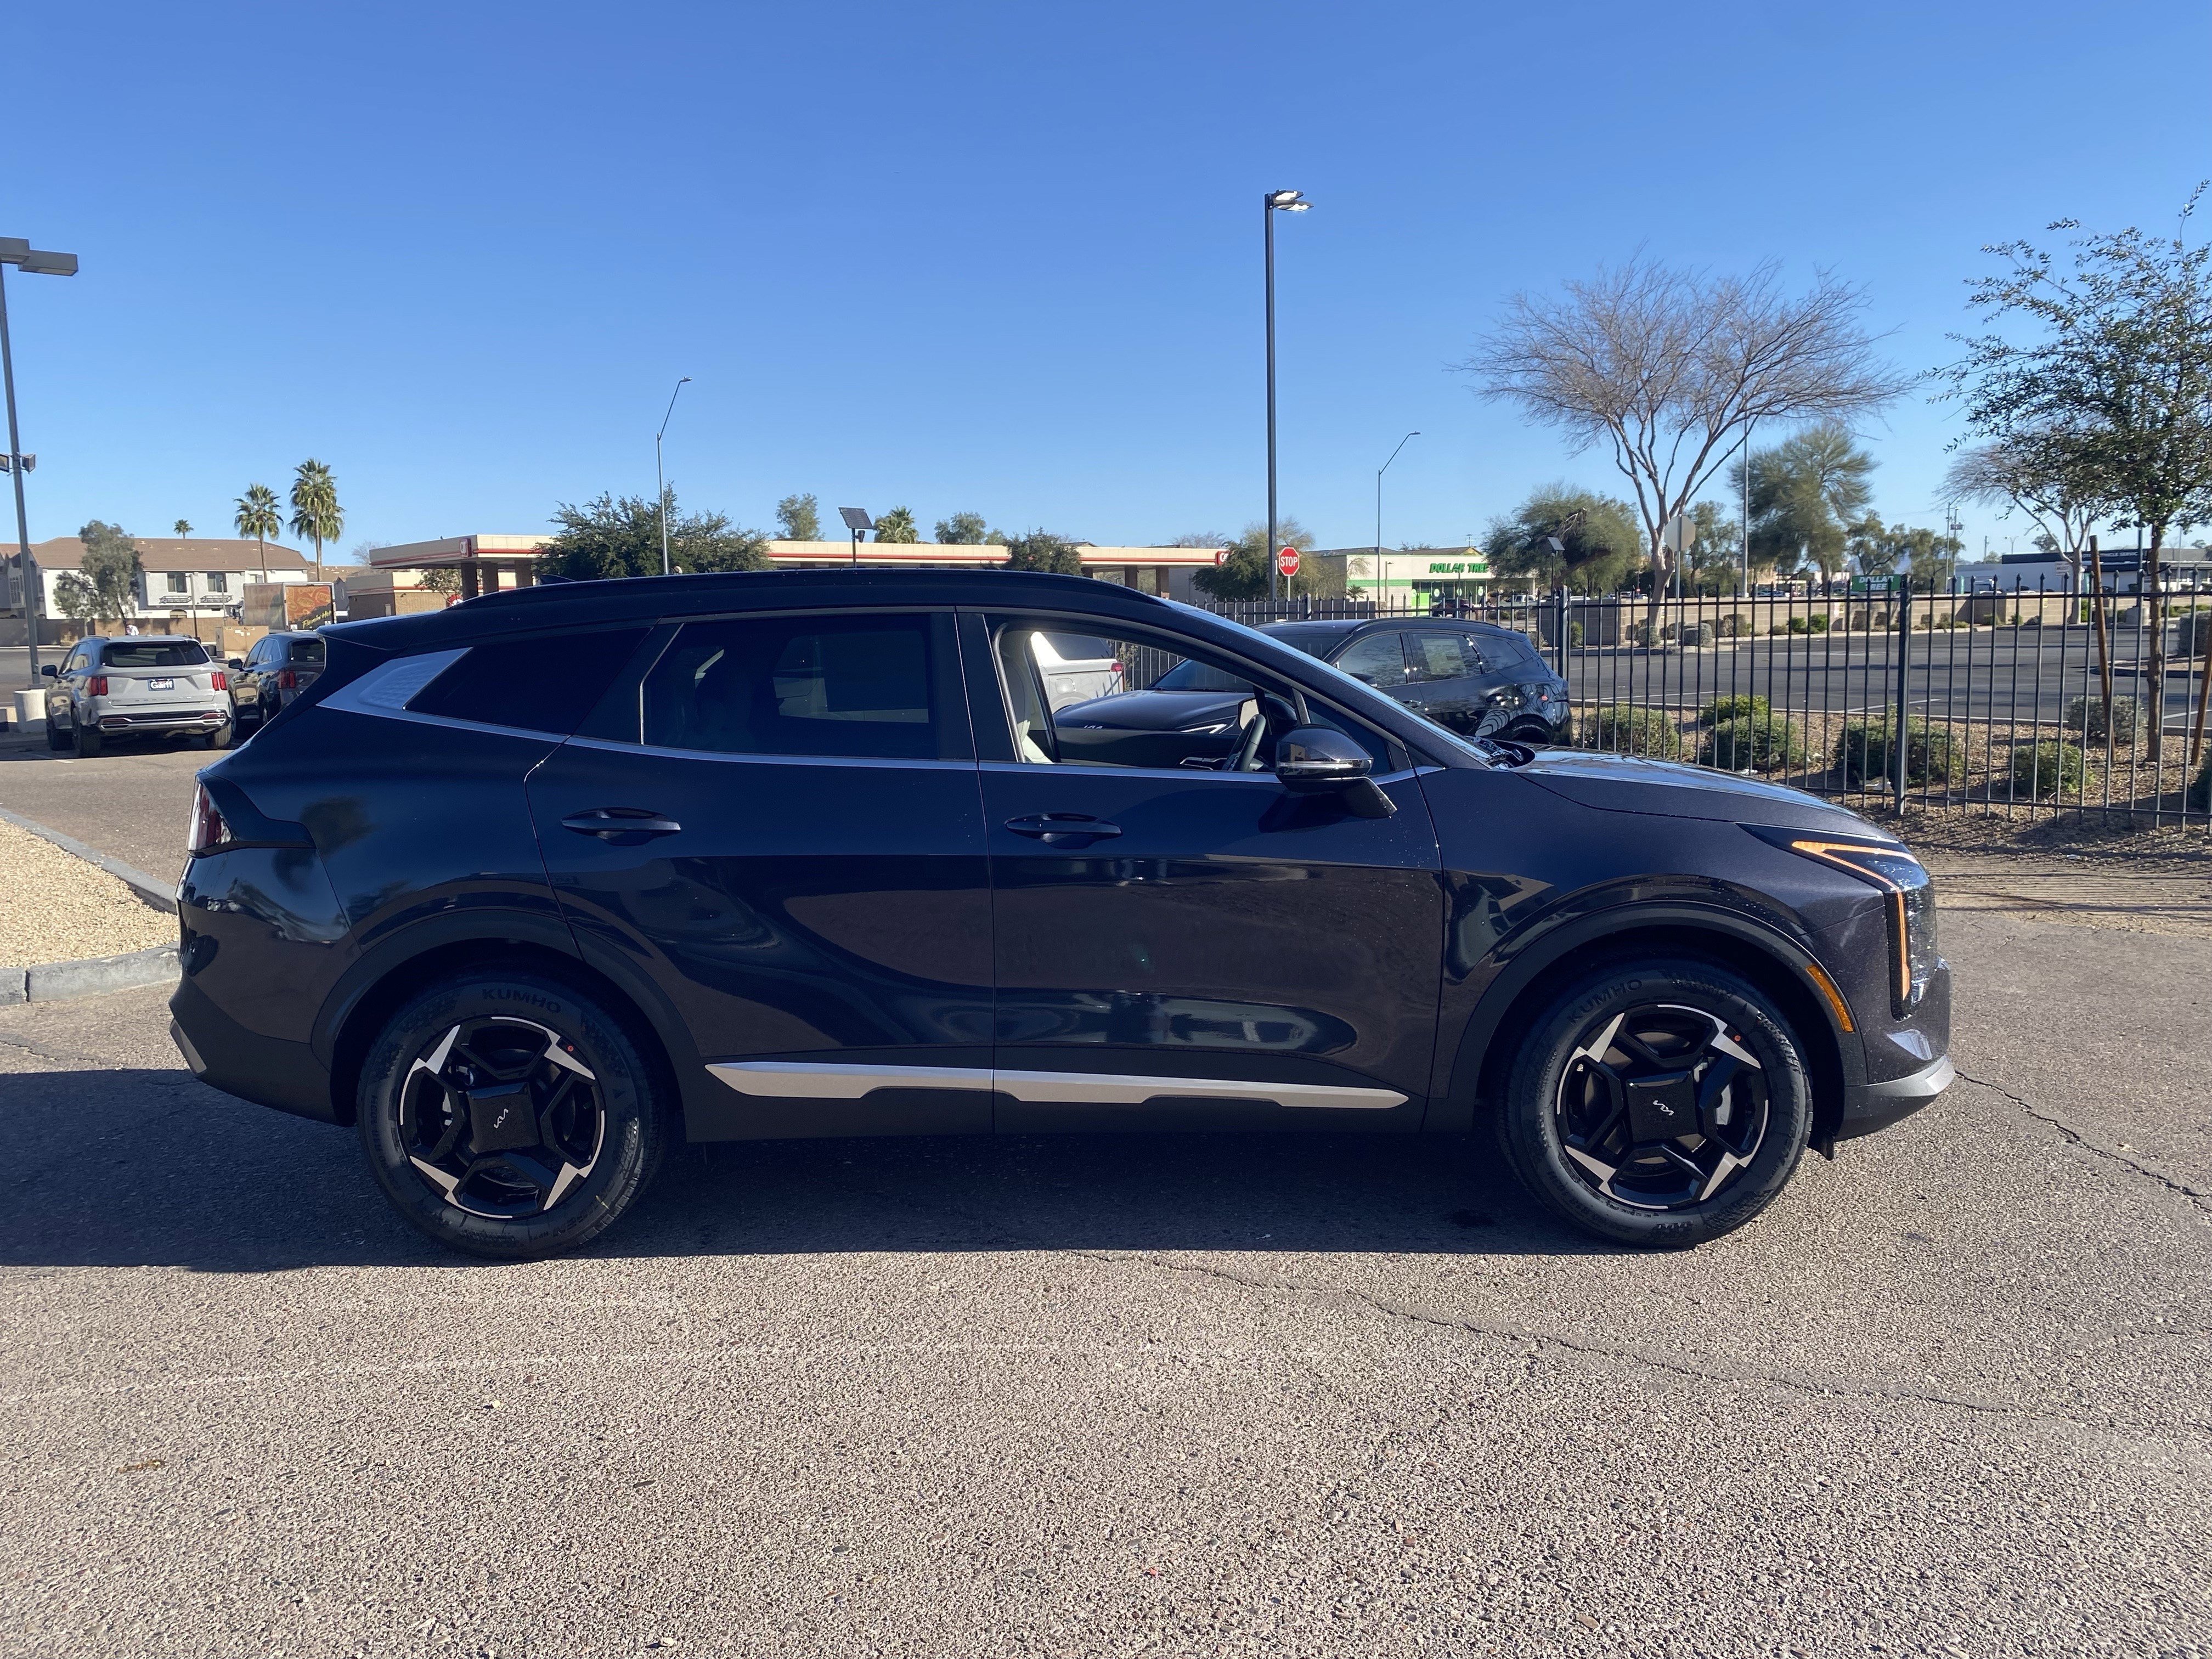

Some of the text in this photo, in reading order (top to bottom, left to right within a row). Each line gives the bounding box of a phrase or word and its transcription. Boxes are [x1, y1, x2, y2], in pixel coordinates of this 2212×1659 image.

[1280, 556, 1298, 567] STOP
[1429, 563, 1465, 573] DOLLAR
[482, 988, 561, 1014] KUMHO
[1567, 979, 1642, 1026] KUMHO
